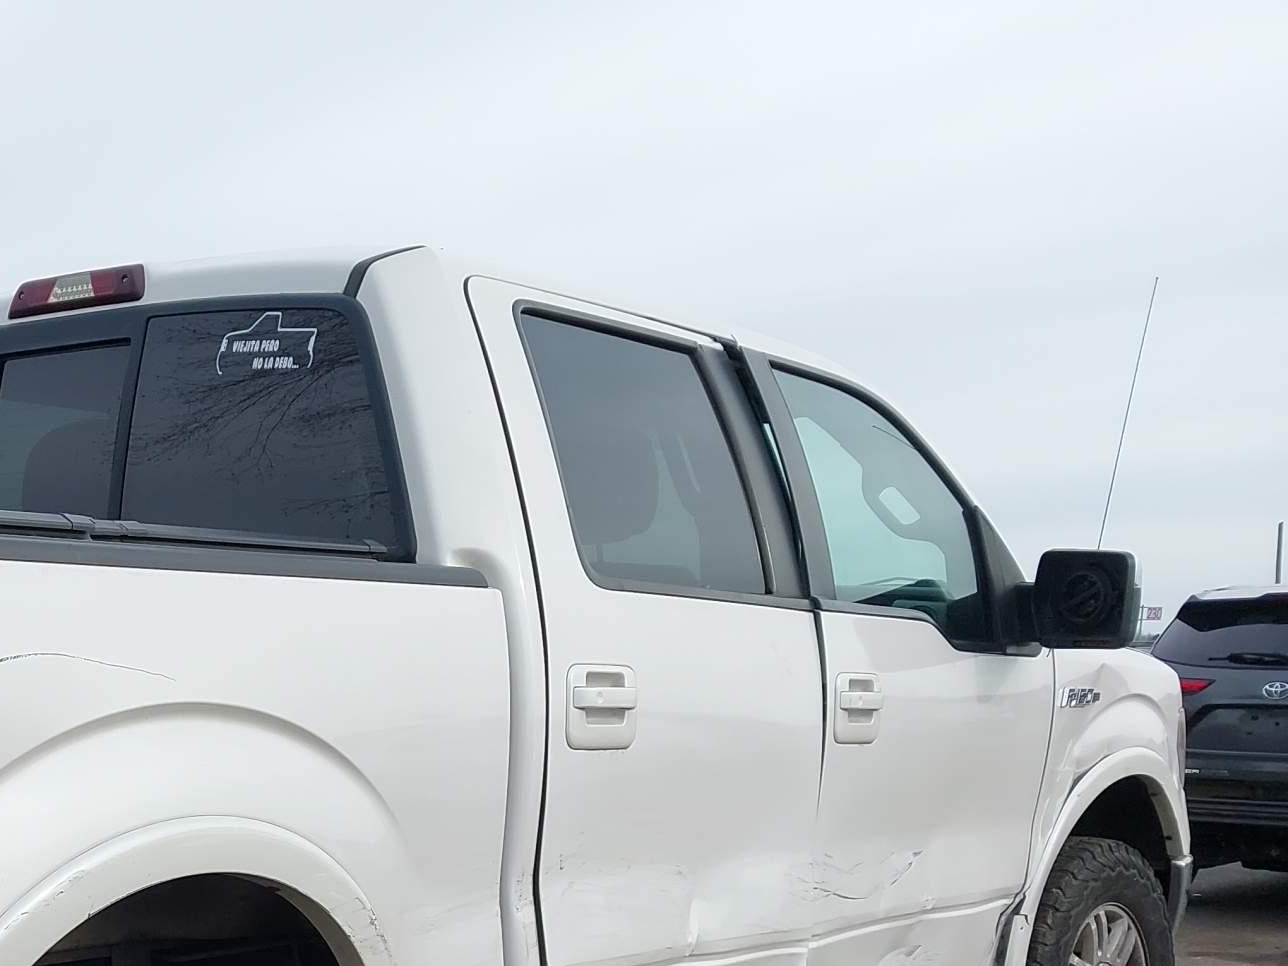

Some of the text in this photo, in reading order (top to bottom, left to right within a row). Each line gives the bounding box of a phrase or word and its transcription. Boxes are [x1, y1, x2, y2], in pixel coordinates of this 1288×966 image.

[260, 339, 280, 352] PERO
[252, 357, 263, 370] NO
[263, 357, 274, 369] LA
